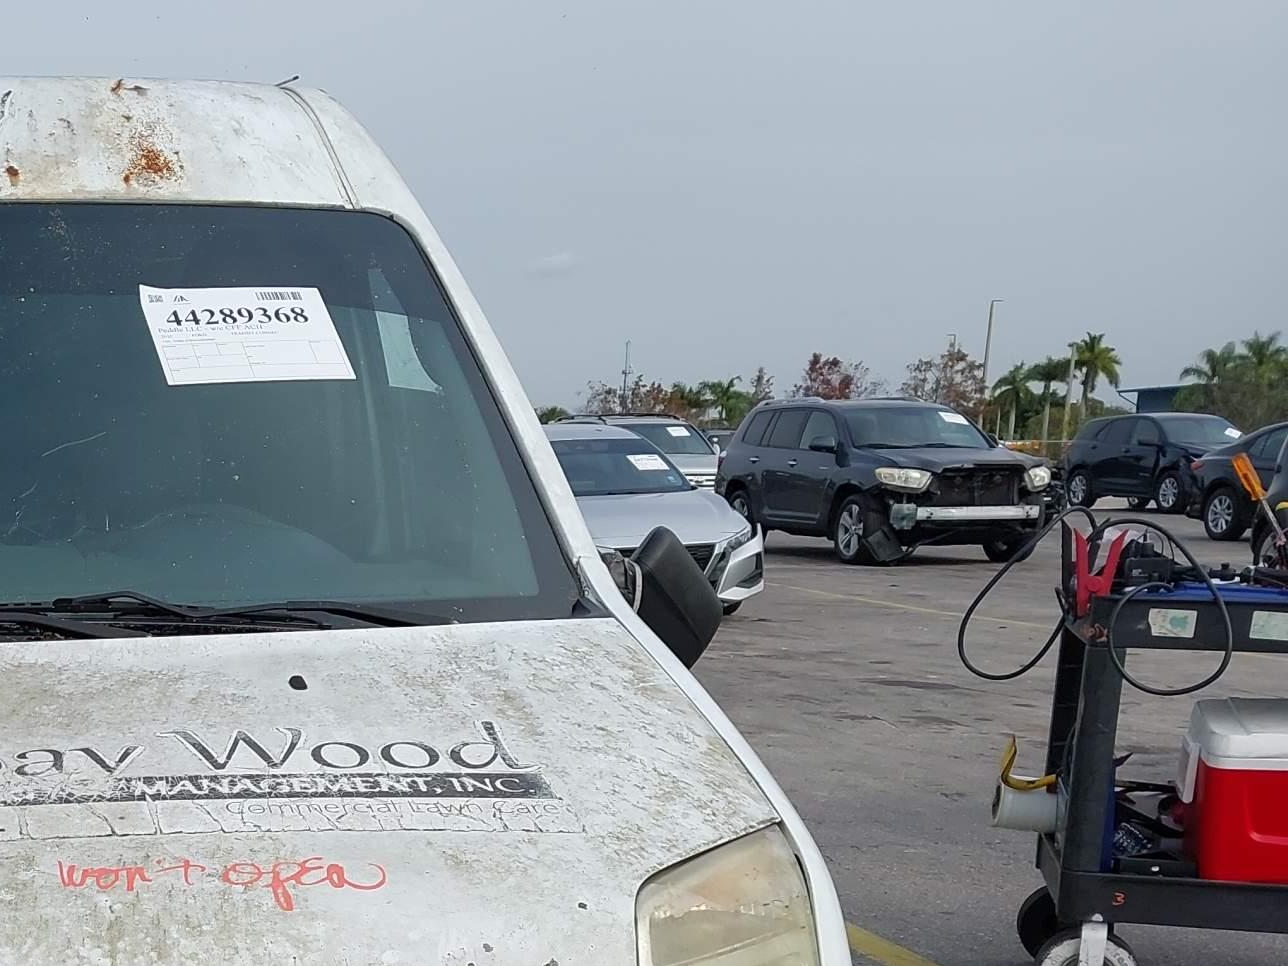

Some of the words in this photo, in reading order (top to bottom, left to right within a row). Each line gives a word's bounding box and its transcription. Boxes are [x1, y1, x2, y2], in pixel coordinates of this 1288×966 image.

[166, 307, 309, 326] 44289368
[158, 720, 535, 773] Wood
[449, 776, 536, 794] INC.
